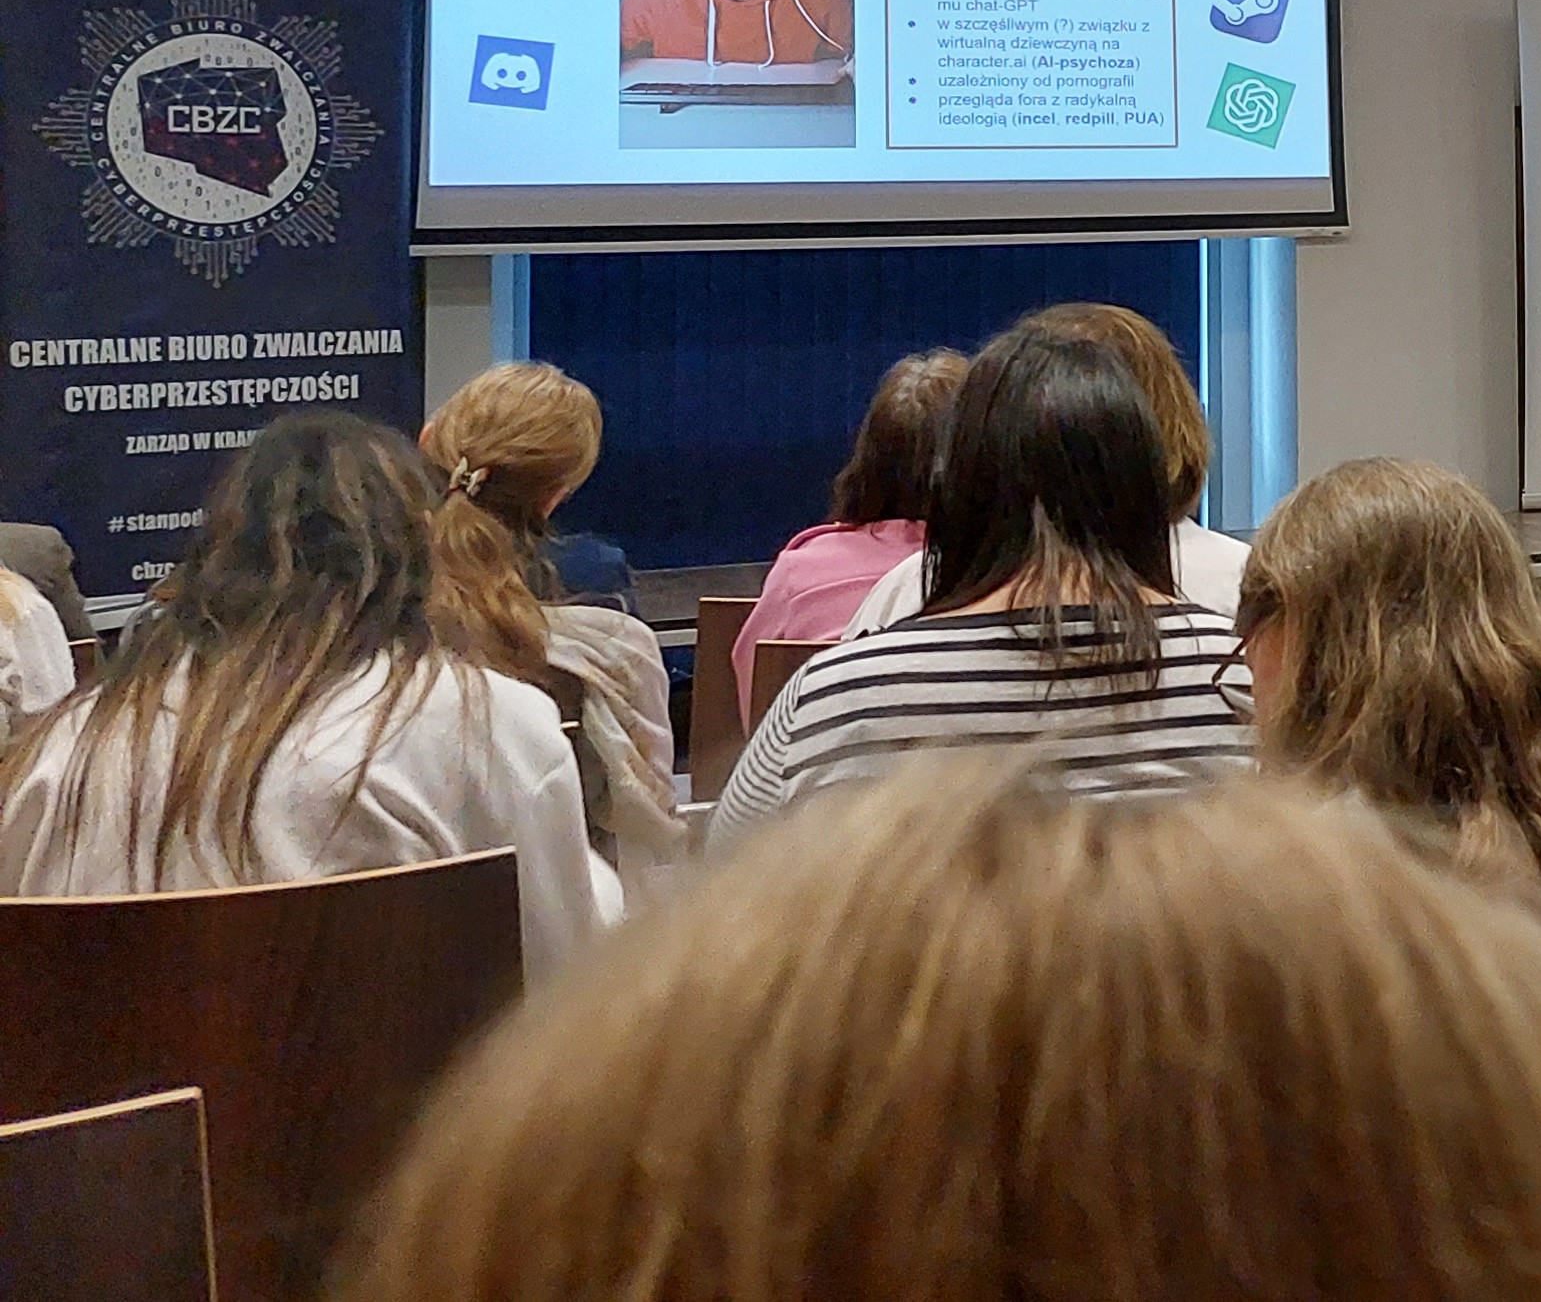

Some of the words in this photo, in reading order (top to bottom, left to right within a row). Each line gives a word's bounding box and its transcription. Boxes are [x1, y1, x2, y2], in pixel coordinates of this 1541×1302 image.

[938, 2, 960, 11] mu
[966, 0, 1039, 11] chat-GPT
[938, 20, 950, 30] w
[955, 18, 1048, 34] szczęśliwym
[1054, 18, 1075, 33] (?)
[1078, 19, 1137, 34] związku
[1141, 23, 1150, 32] z
[938, 37, 1006, 51] wirtualną
[1010, 37, 1097, 52] dziewczyną
[1101, 40, 1120, 49] na
[938, 55, 1026, 68] character.ai
[1032, 55, 1140, 71] (AI-psychoza)
[92, 33, 158, 142] CENTRALNE
[171, 20, 242, 34] BIURO
[256, 32, 330, 144] ZWALCZANIA
[939, 75, 1028, 89] uzależniony
[1033, 75, 1051, 86] od
[1056, 75, 1134, 89] pornografii
[939, 95, 1013, 109] przegląda
[1018, 94, 1046, 106] fora
[1052, 96, 1060, 106] z
[1065, 94, 1136, 109] radykalną
[168, 106, 261, 134] CBZC
[939, 113, 1007, 128] ideologią
[1012, 113, 1060, 127] (incel,
[1065, 113, 1120, 127] redpill,
[1124, 113, 1164, 127] PUA)
[9, 336, 162, 369] CENTRALNE
[168, 334, 247, 361] BIURO
[253, 329, 403, 358] ZWALCZANIA
[65, 371, 359, 412] CYBERPRZESTĘPCZOŚCI
[126, 431, 189, 455] ZARZĄD
[193, 432, 211, 450] W
[215, 428, 259, 449] KRAK
